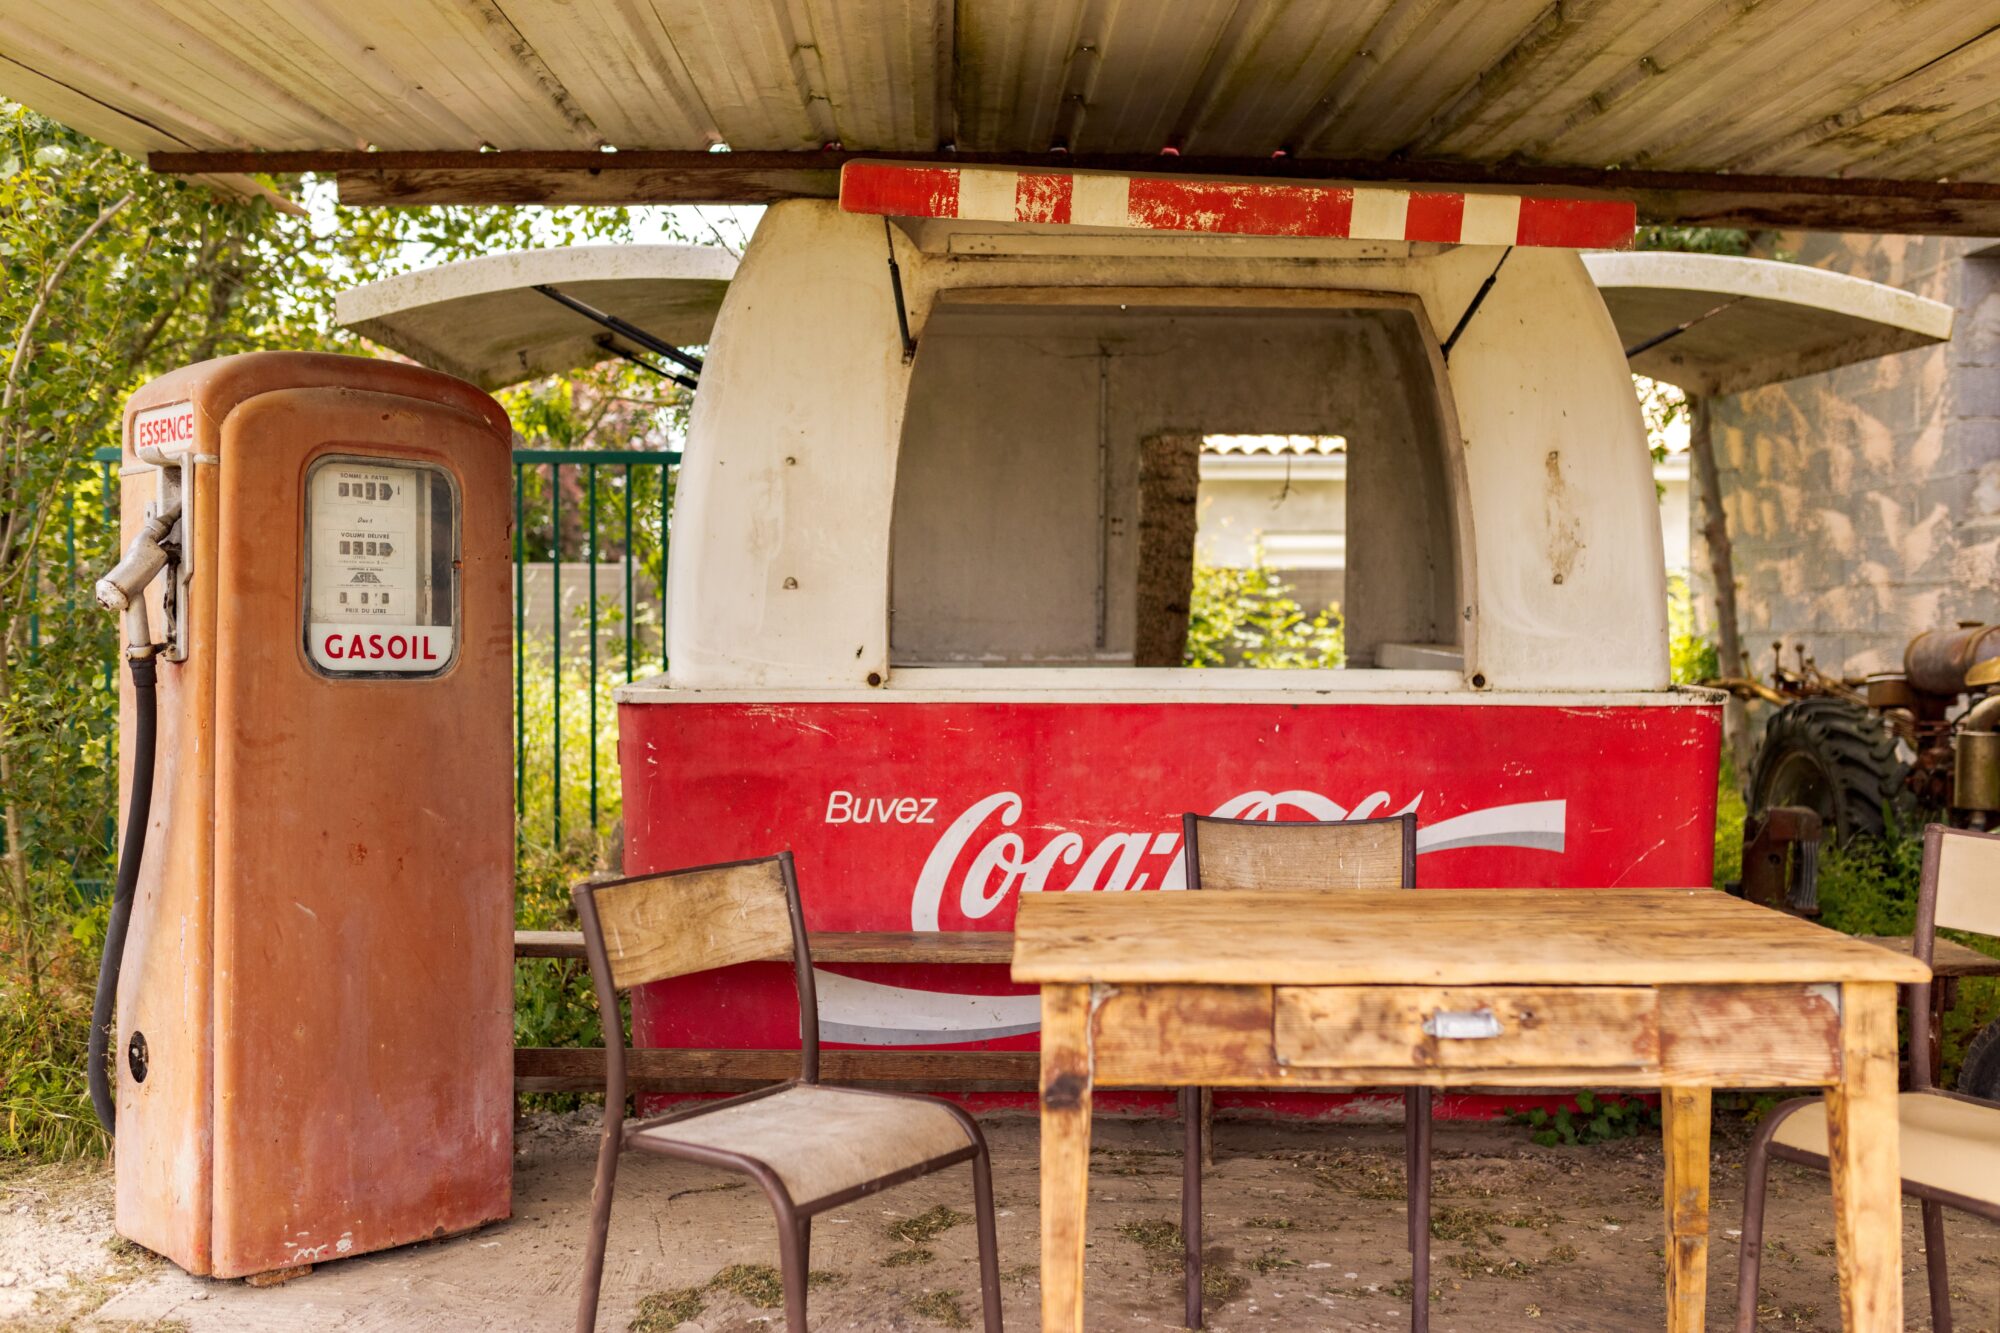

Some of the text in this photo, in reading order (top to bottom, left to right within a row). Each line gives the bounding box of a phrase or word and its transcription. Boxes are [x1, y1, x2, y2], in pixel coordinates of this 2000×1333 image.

[139, 413, 193, 447] ESSENCE
[324, 634, 437, 660] GASOIL
[825, 790, 938, 824] Buvez
